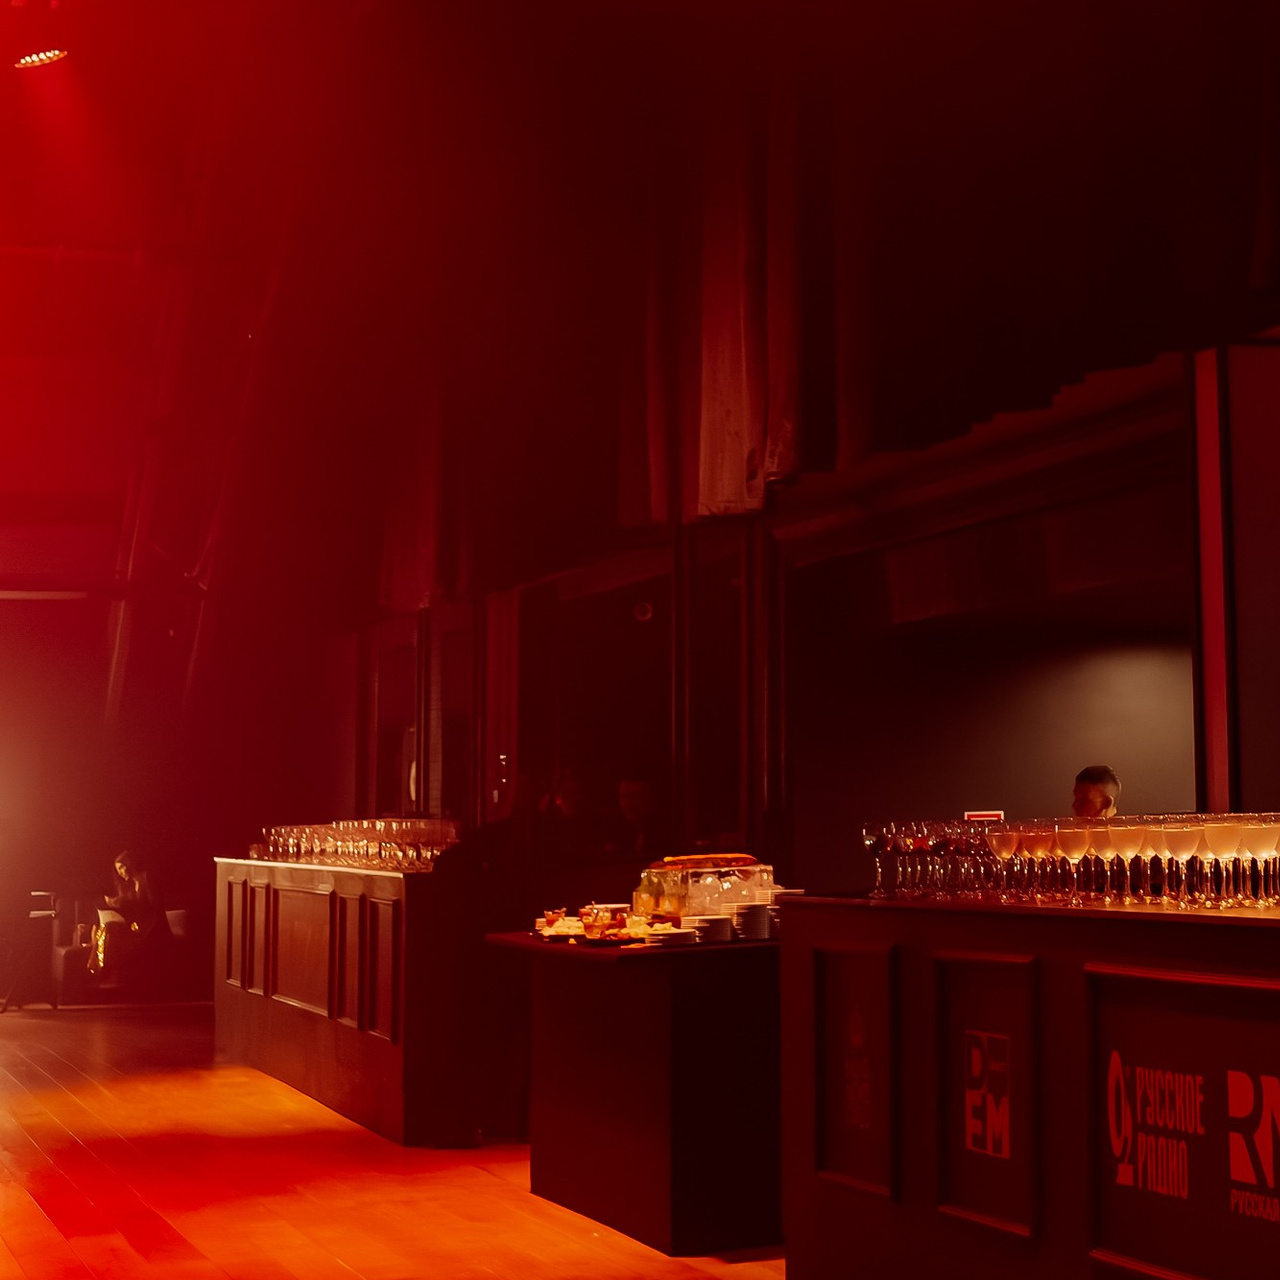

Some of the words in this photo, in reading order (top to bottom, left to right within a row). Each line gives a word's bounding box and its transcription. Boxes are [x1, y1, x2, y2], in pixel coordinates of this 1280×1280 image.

[1136, 1067, 1205, 1134] РУССКОЕ
[1138, 1133, 1188, 1199] РАДИО
[1230, 1189, 1280, 1223] РУССКАЯ
